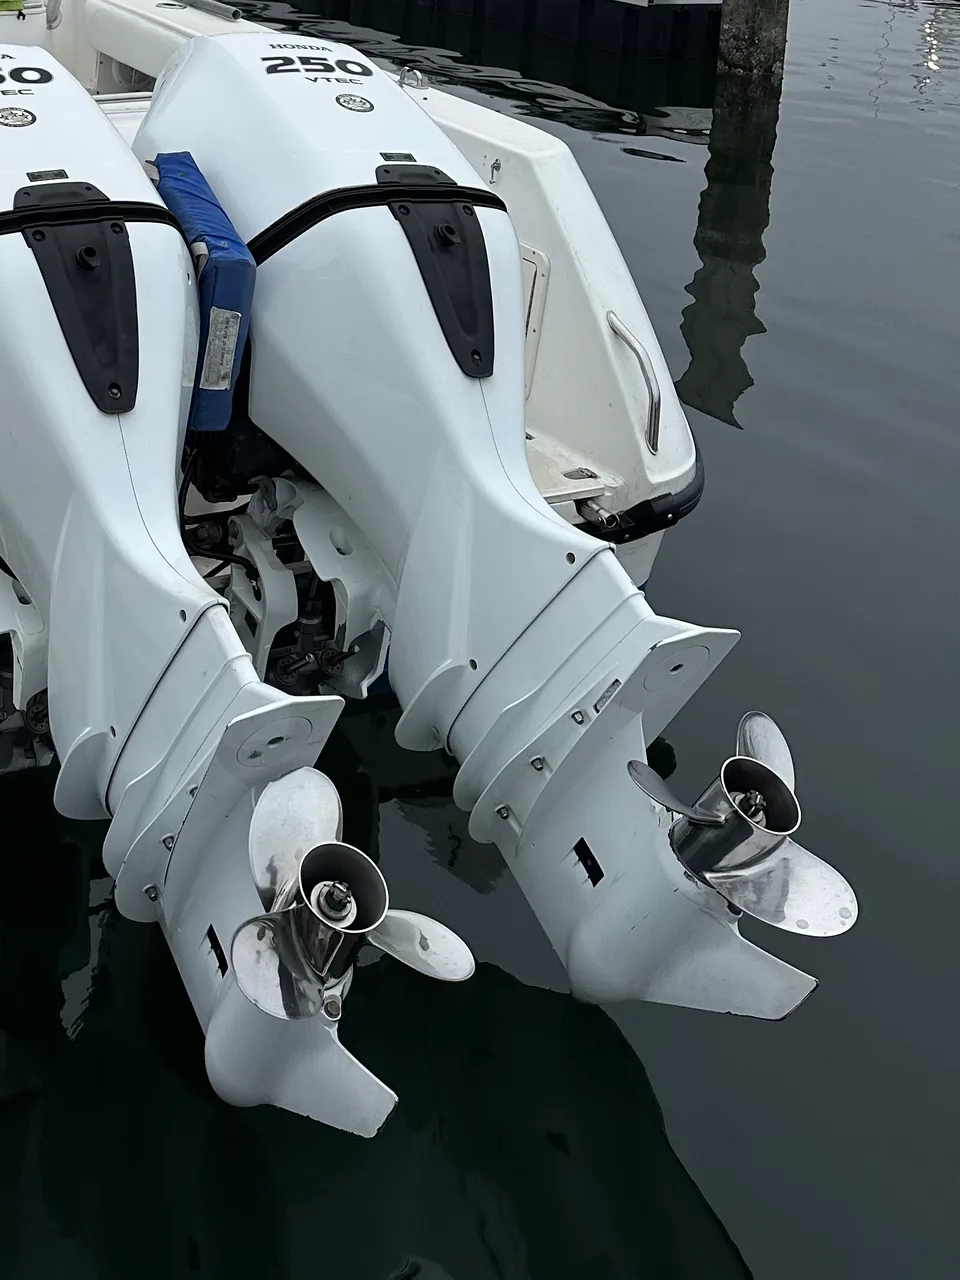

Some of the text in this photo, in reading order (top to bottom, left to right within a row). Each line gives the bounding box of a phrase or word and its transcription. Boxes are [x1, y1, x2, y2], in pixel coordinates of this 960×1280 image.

[268, 43, 335, 53] HONDA
[260, 56, 375, 77] 250
[304, 76, 364, 85] VTEC
